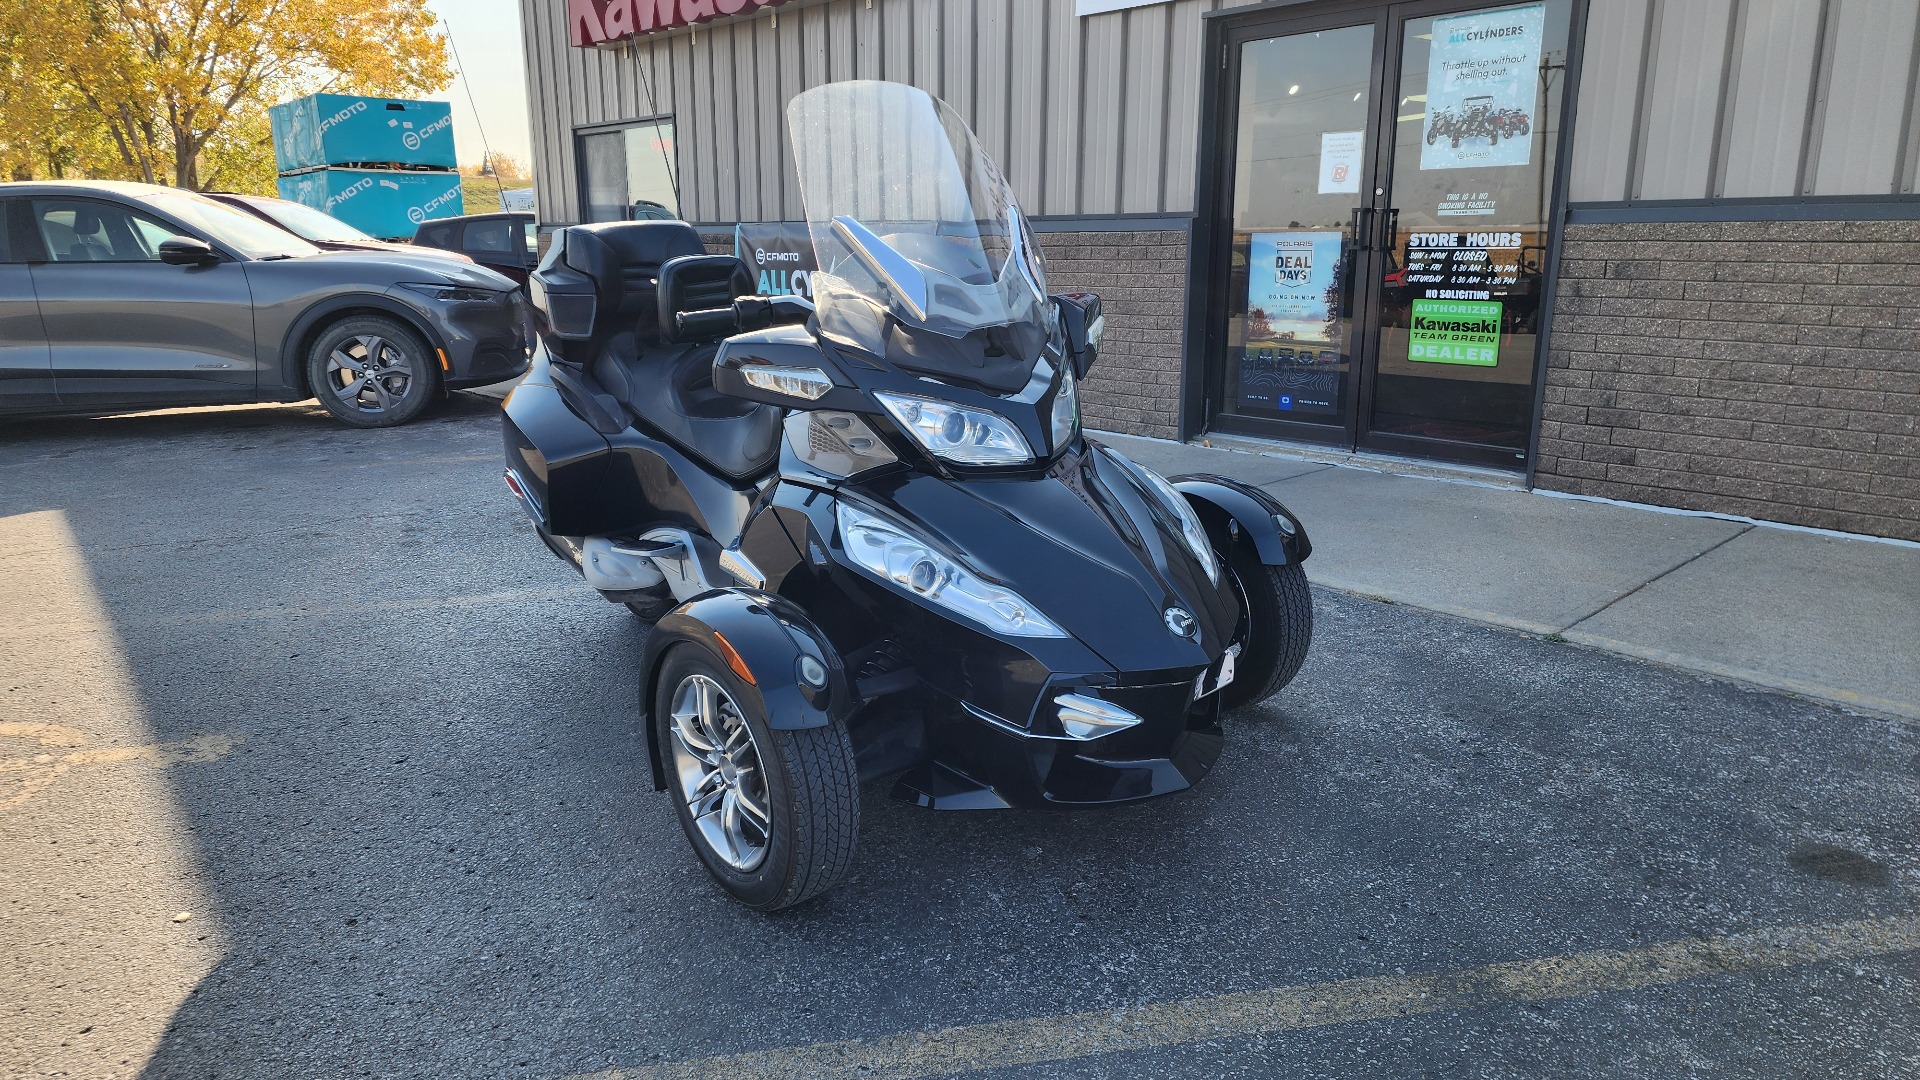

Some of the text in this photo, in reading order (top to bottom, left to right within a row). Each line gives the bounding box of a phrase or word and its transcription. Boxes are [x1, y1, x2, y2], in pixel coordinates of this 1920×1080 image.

[1442, 54, 1527, 71] Throttle up without
[1456, 67, 1508, 80] shelling out.
[1409, 232, 1522, 247] STORE HOURS
[766, 252, 799, 262] CFMOTO
[1409, 251, 1424, 260] SUN
[1429, 251, 1448, 260] MON
[1452, 250, 1488, 261] CLOSED
[1275, 256, 1312, 269] DEAL
[1408, 262, 1425, 271] TUES
[1429, 263, 1443, 271] FRI
[1467, 263, 1482, 272] AM
[1503, 264, 1518, 273] PM
[1279, 270, 1308, 281] DAYS
[1407, 275, 1445, 283] SATURDAY
[1465, 275, 1481, 284] AM
[1502, 276, 1517, 285] PM
[1425, 289, 1438, 299] NO
[1439, 290, 1490, 300] SOLICITING
[1415, 304, 1499, 315] AUTHORIZED
[1414, 316, 1498, 334] Kawasaki
[1413, 332, 1495, 343] TEAM GREEN
[1411, 344, 1495, 362] DEALER
